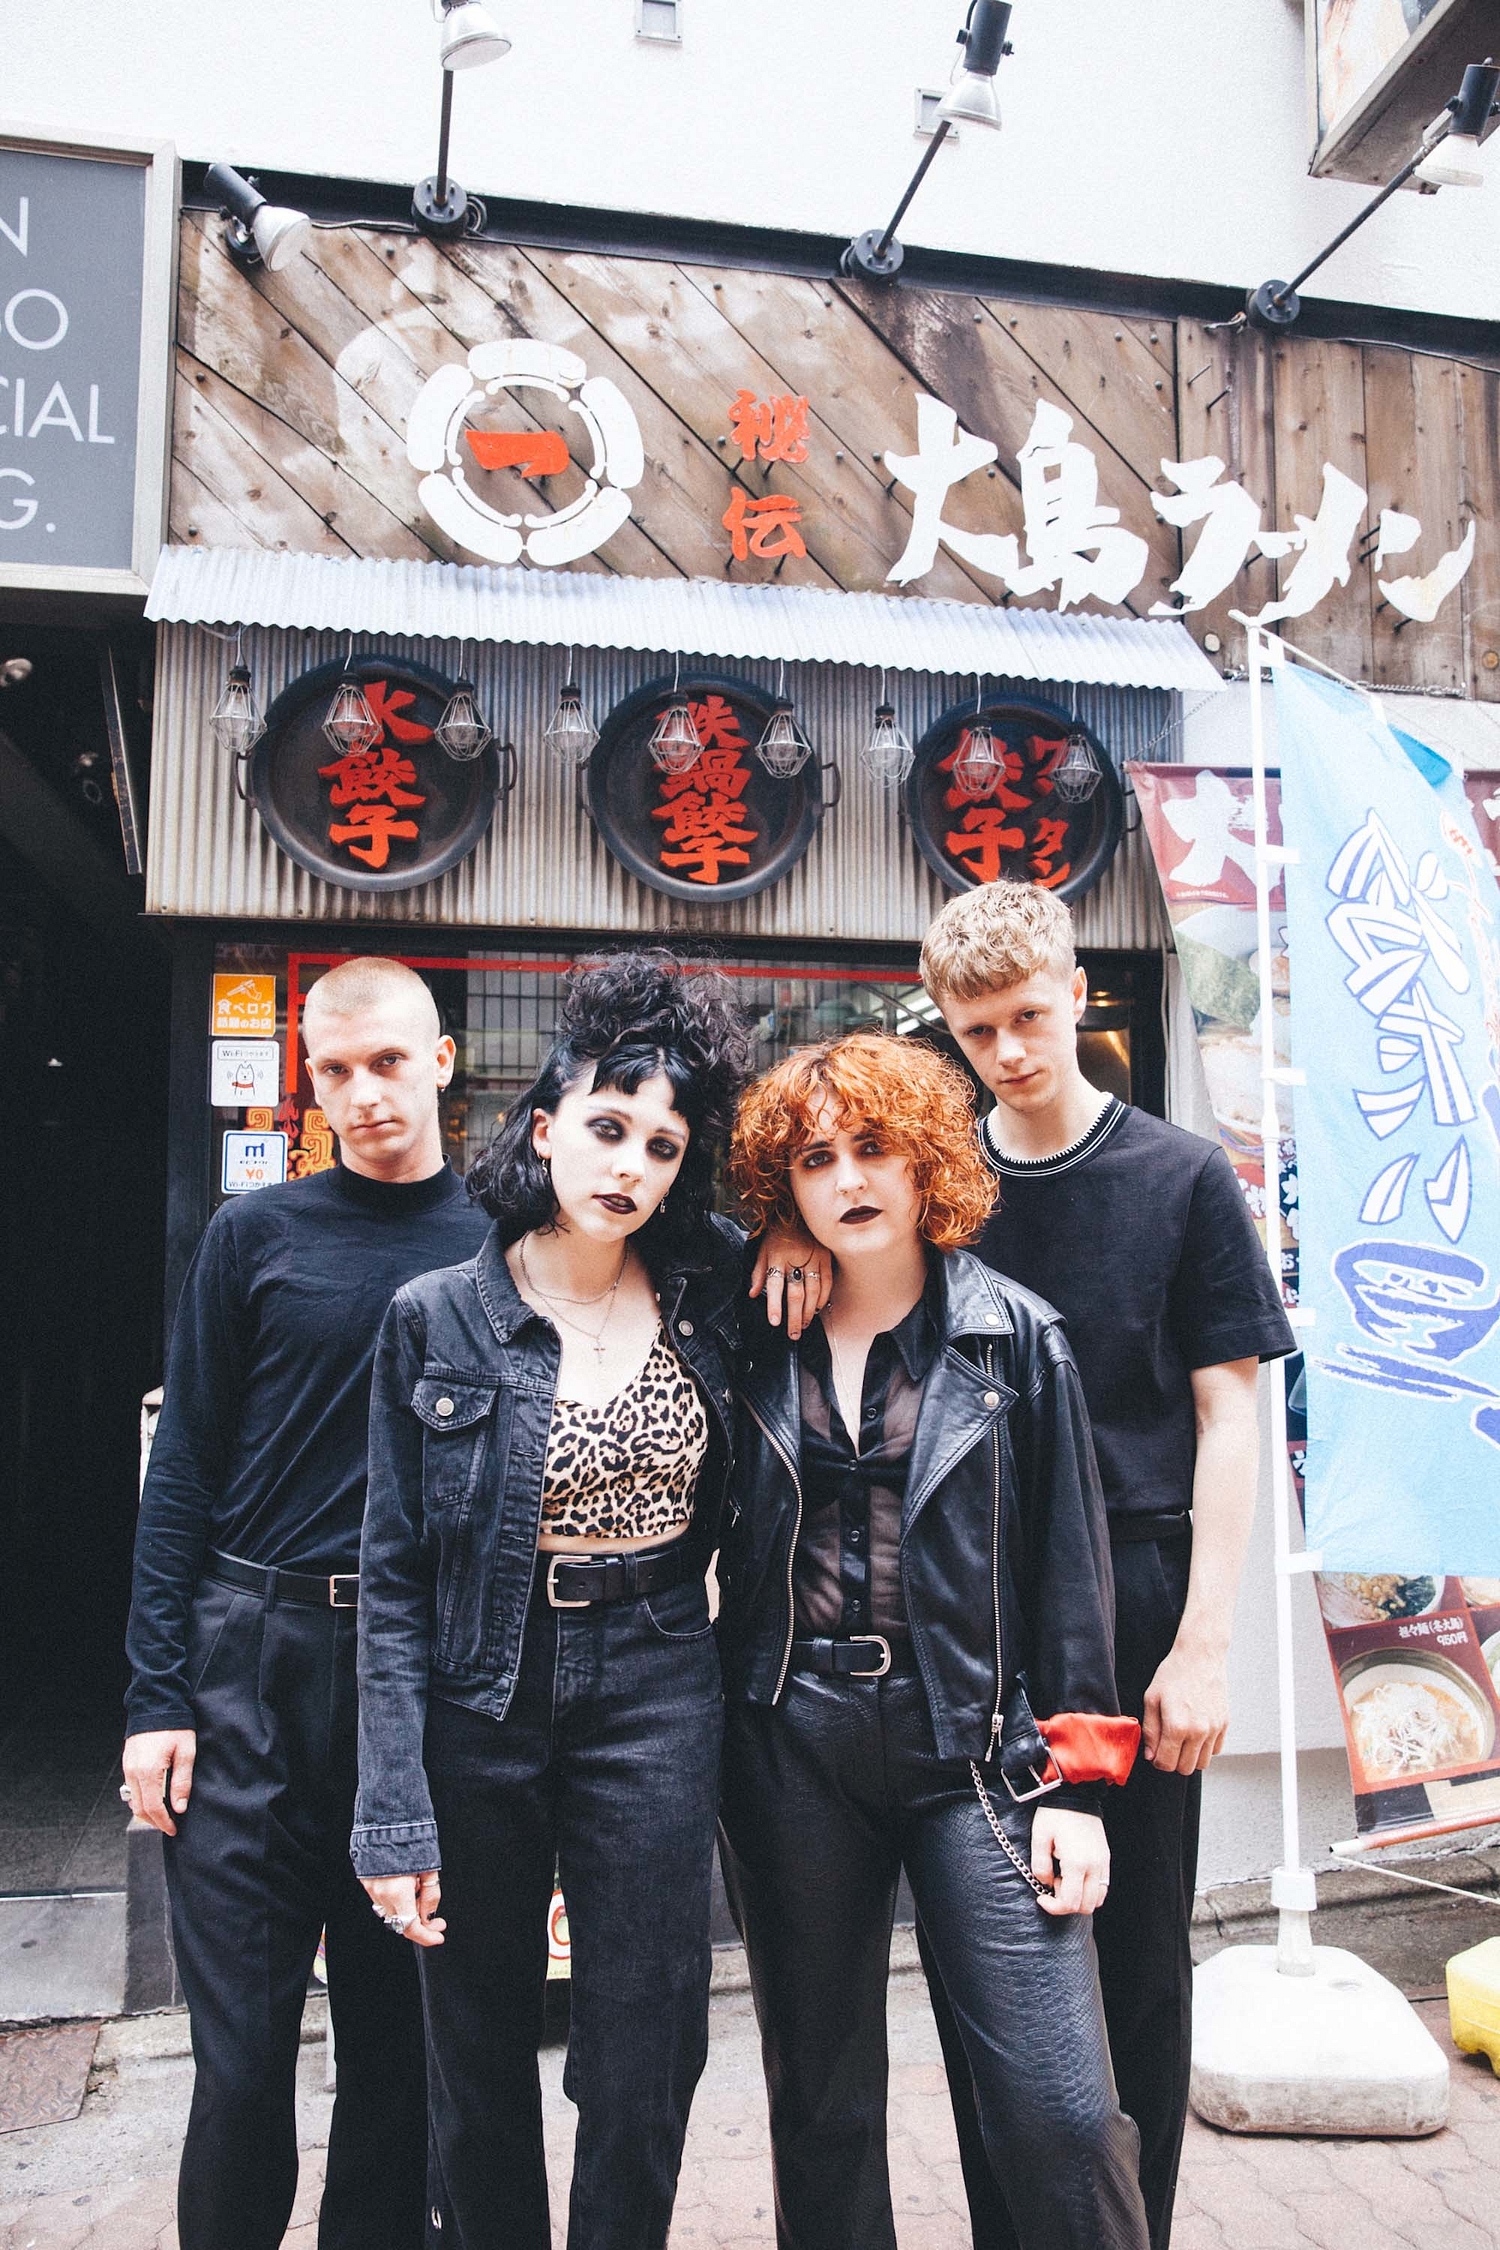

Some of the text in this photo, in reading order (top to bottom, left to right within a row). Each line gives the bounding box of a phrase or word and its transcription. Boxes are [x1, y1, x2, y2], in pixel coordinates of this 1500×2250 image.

[0, 288, 69, 350] O
[318, 680, 435, 868] 水餃子
[216, 999, 272, 1016] 食べログ
